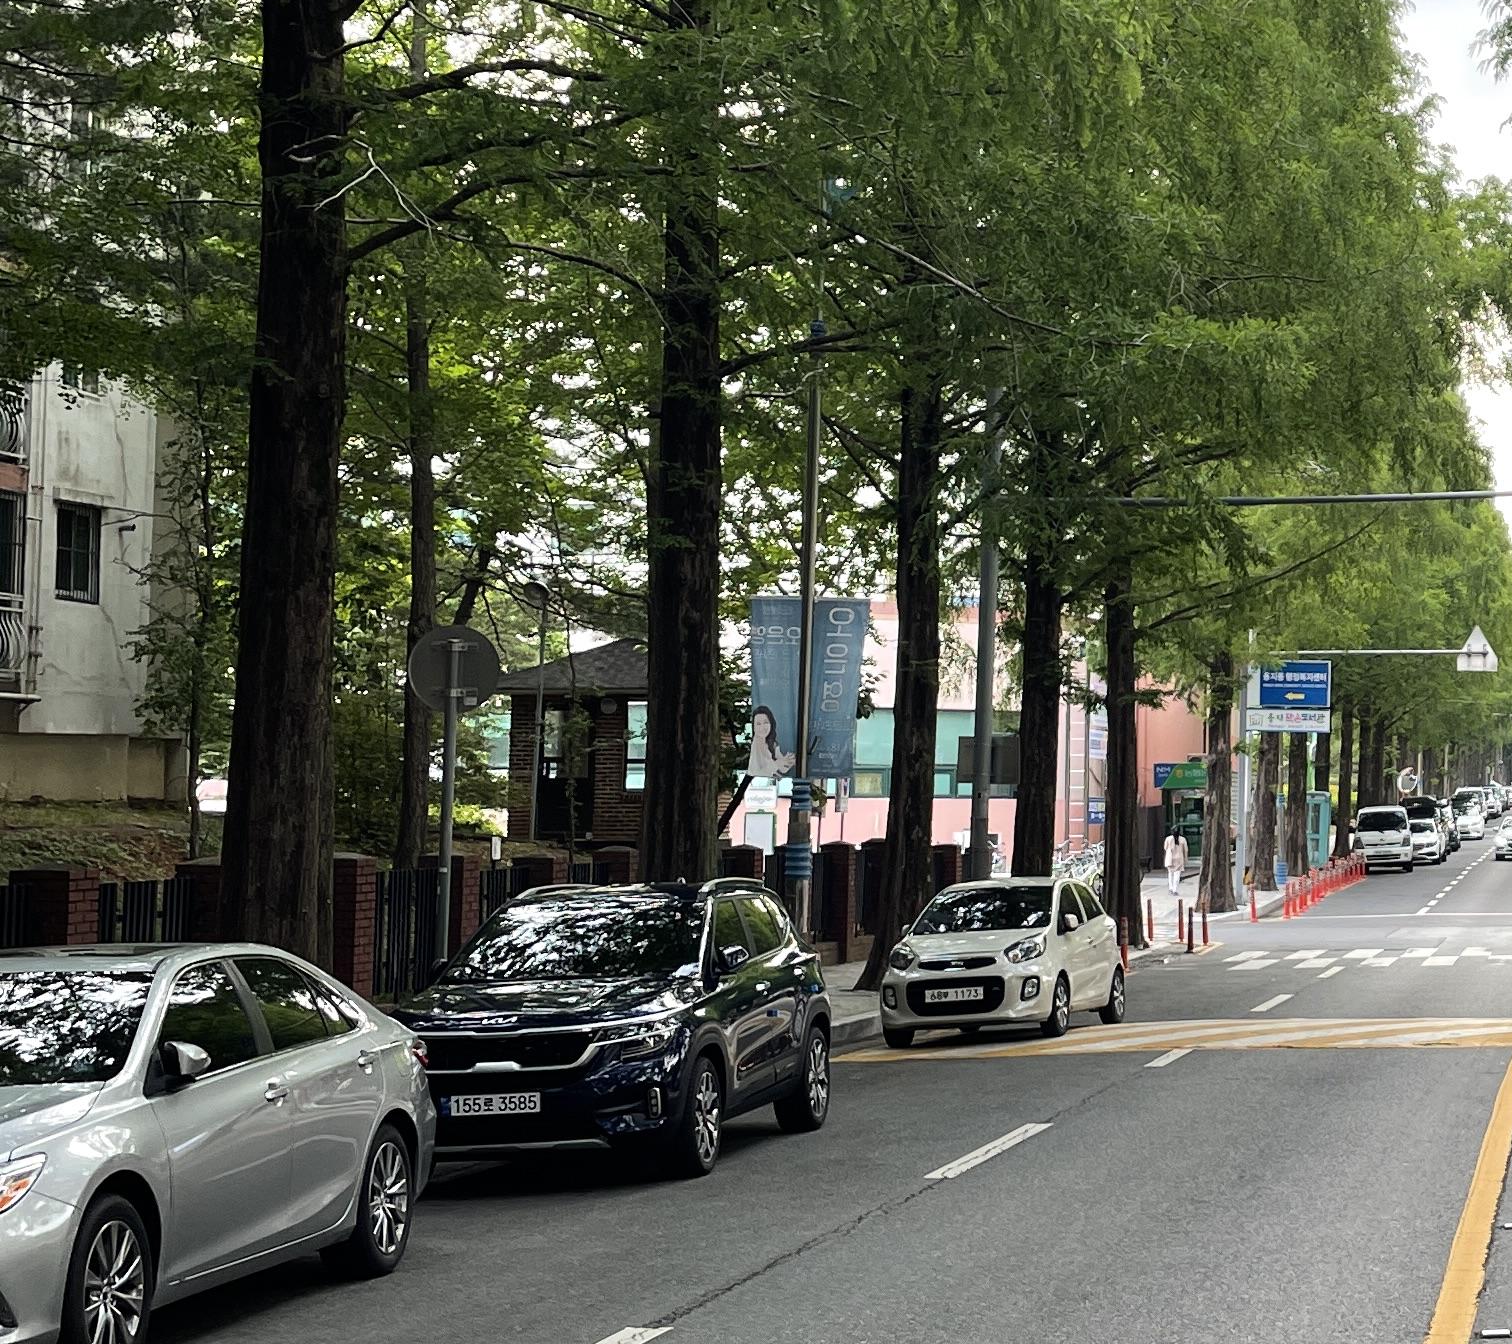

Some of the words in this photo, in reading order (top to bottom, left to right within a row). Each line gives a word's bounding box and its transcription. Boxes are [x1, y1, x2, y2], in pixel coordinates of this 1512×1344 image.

[954, 988, 979, 1000] 1173
[453, 1097, 494, 1114] 155로
[498, 1095, 537, 1112] 3585
